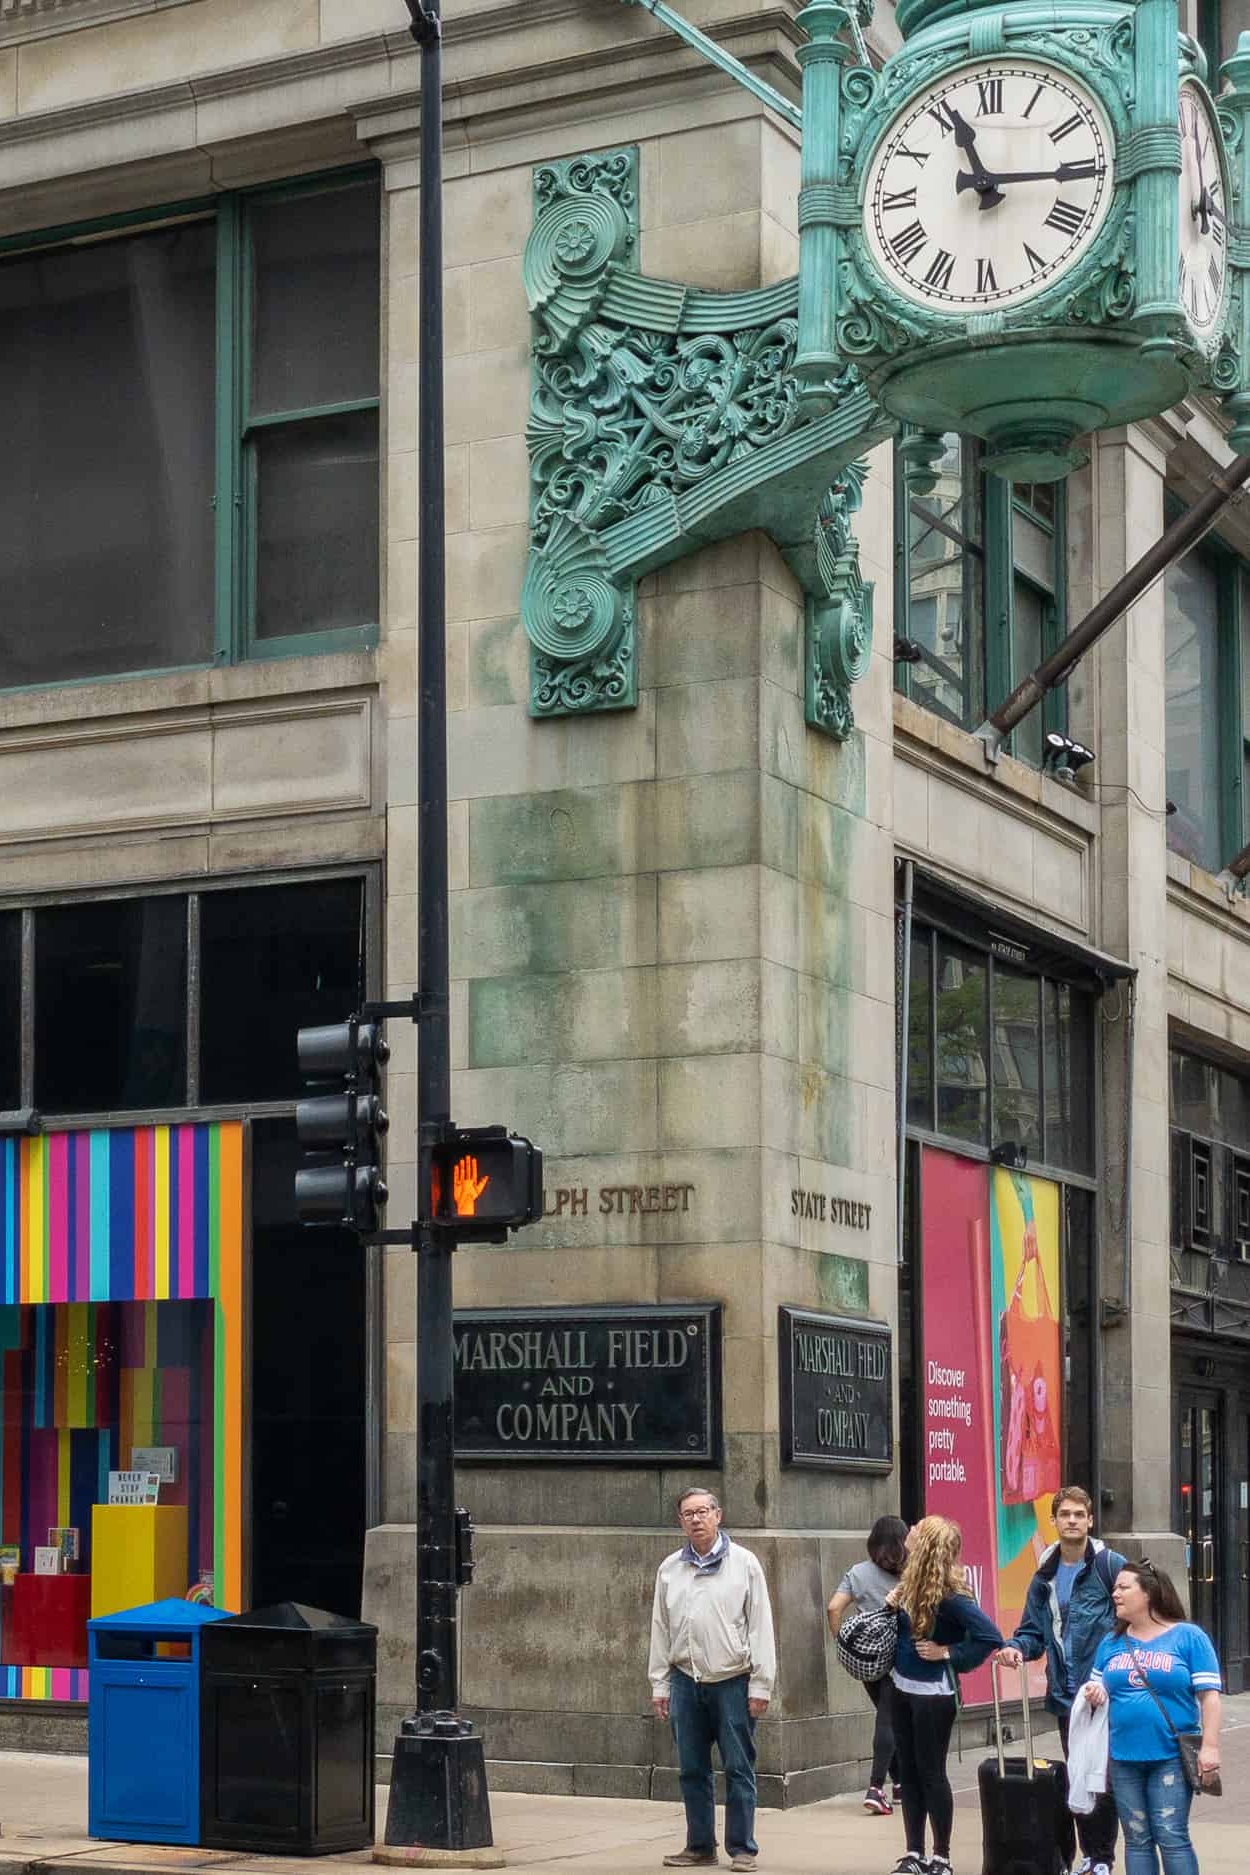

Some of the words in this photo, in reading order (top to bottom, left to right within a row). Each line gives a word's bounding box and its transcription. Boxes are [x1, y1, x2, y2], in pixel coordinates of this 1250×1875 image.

[599, 1183, 695, 1215] STREET
[791, 1189, 827, 1222] STATE
[830, 1196, 872, 1232] STREET
[452, 1330, 597, 1370] MARSHALL
[608, 1328, 688, 1369] FIELD
[797, 1333, 855, 1377] MARSHALL
[857, 1342, 887, 1380] FIELD
[540, 1375, 595, 1397] AND
[928, 1360, 965, 1389] Discover
[834, 1383, 855, 1404] AND
[496, 1402, 641, 1442] COMPANY
[928, 1396, 972, 1426] something
[817, 1407, 870, 1449] COMPANY
[928, 1428, 955, 1456] pretty
[929, 1462, 967, 1487] portable.
